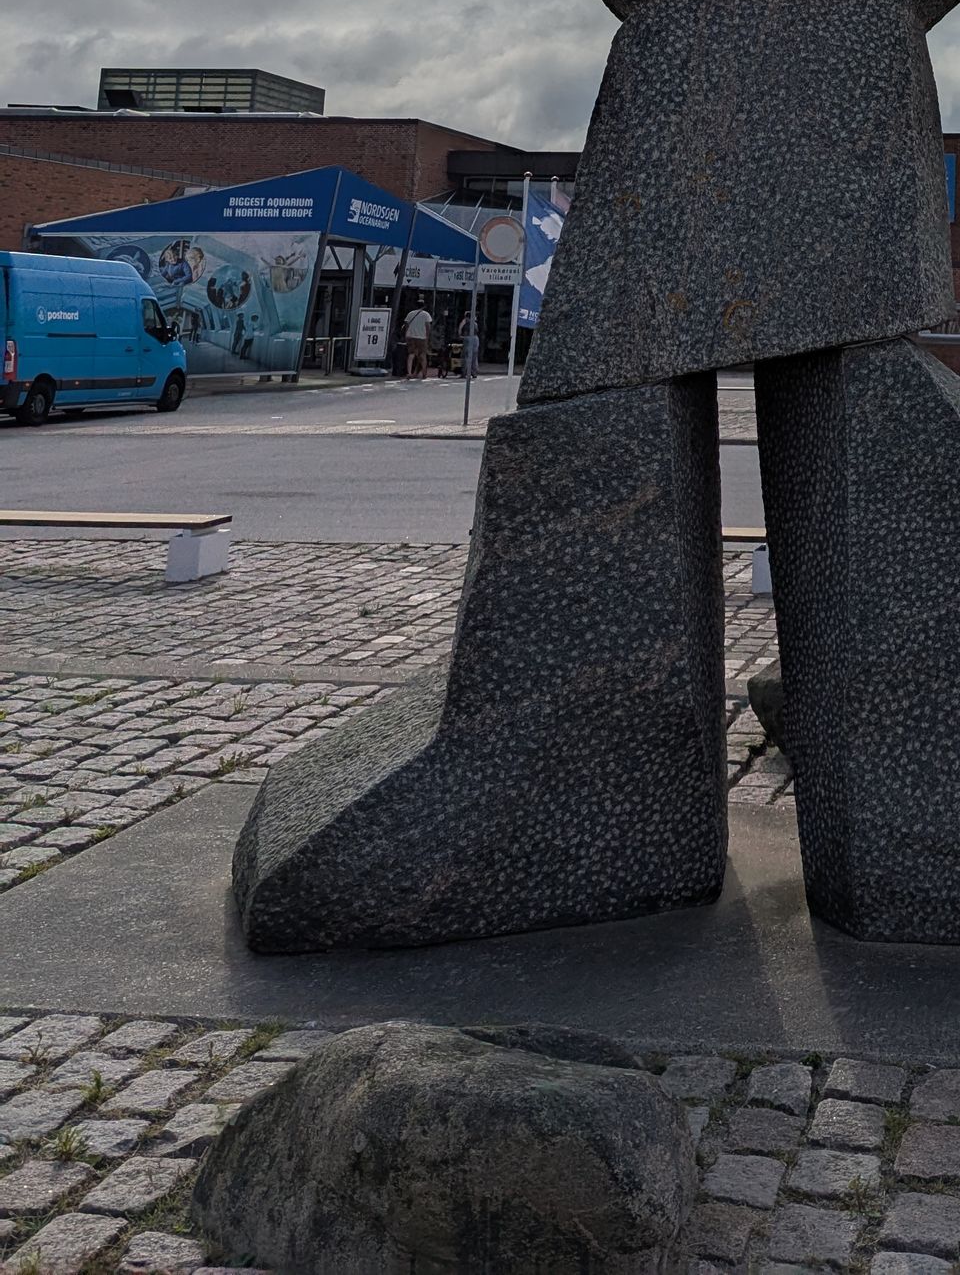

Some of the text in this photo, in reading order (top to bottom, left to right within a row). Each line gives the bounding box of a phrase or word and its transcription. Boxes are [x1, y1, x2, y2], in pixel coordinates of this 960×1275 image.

[229, 197, 314, 208] BIGGEST AQUARIUM
[223, 208, 313, 218] IN NORTHERN EUROPE
[360, 201, 400, 222] NORDSØEN
[358, 215, 391, 230] OCEANARIUM
[47, 310, 79, 322] postnord
[367, 334, 379, 345] 18
